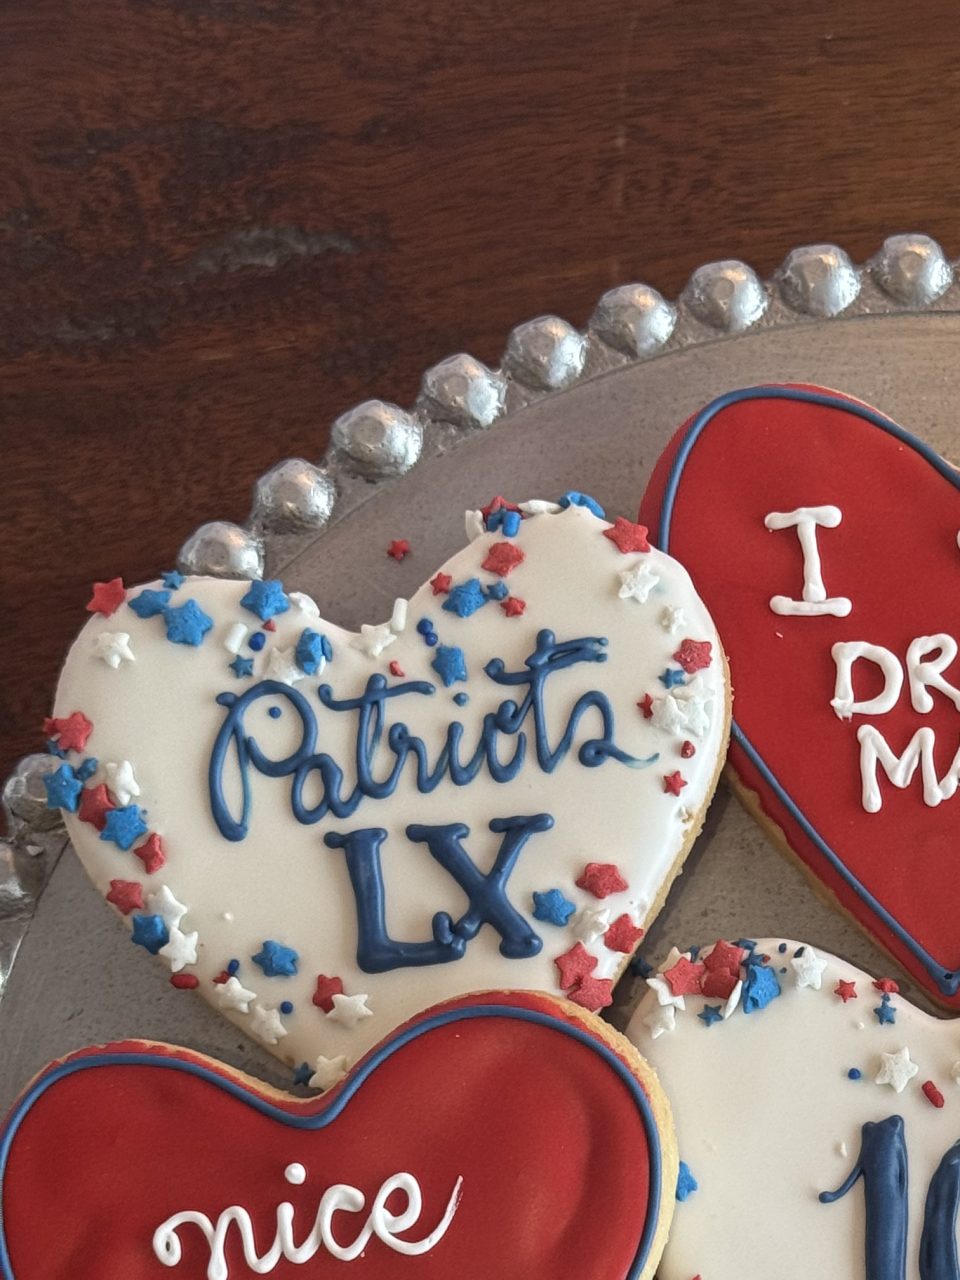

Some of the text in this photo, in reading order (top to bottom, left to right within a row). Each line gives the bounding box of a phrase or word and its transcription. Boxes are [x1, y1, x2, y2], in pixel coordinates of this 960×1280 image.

[765, 505, 852, 617] I
[209, 629, 659, 841] Patriots
[324, 812, 554, 973] LX
